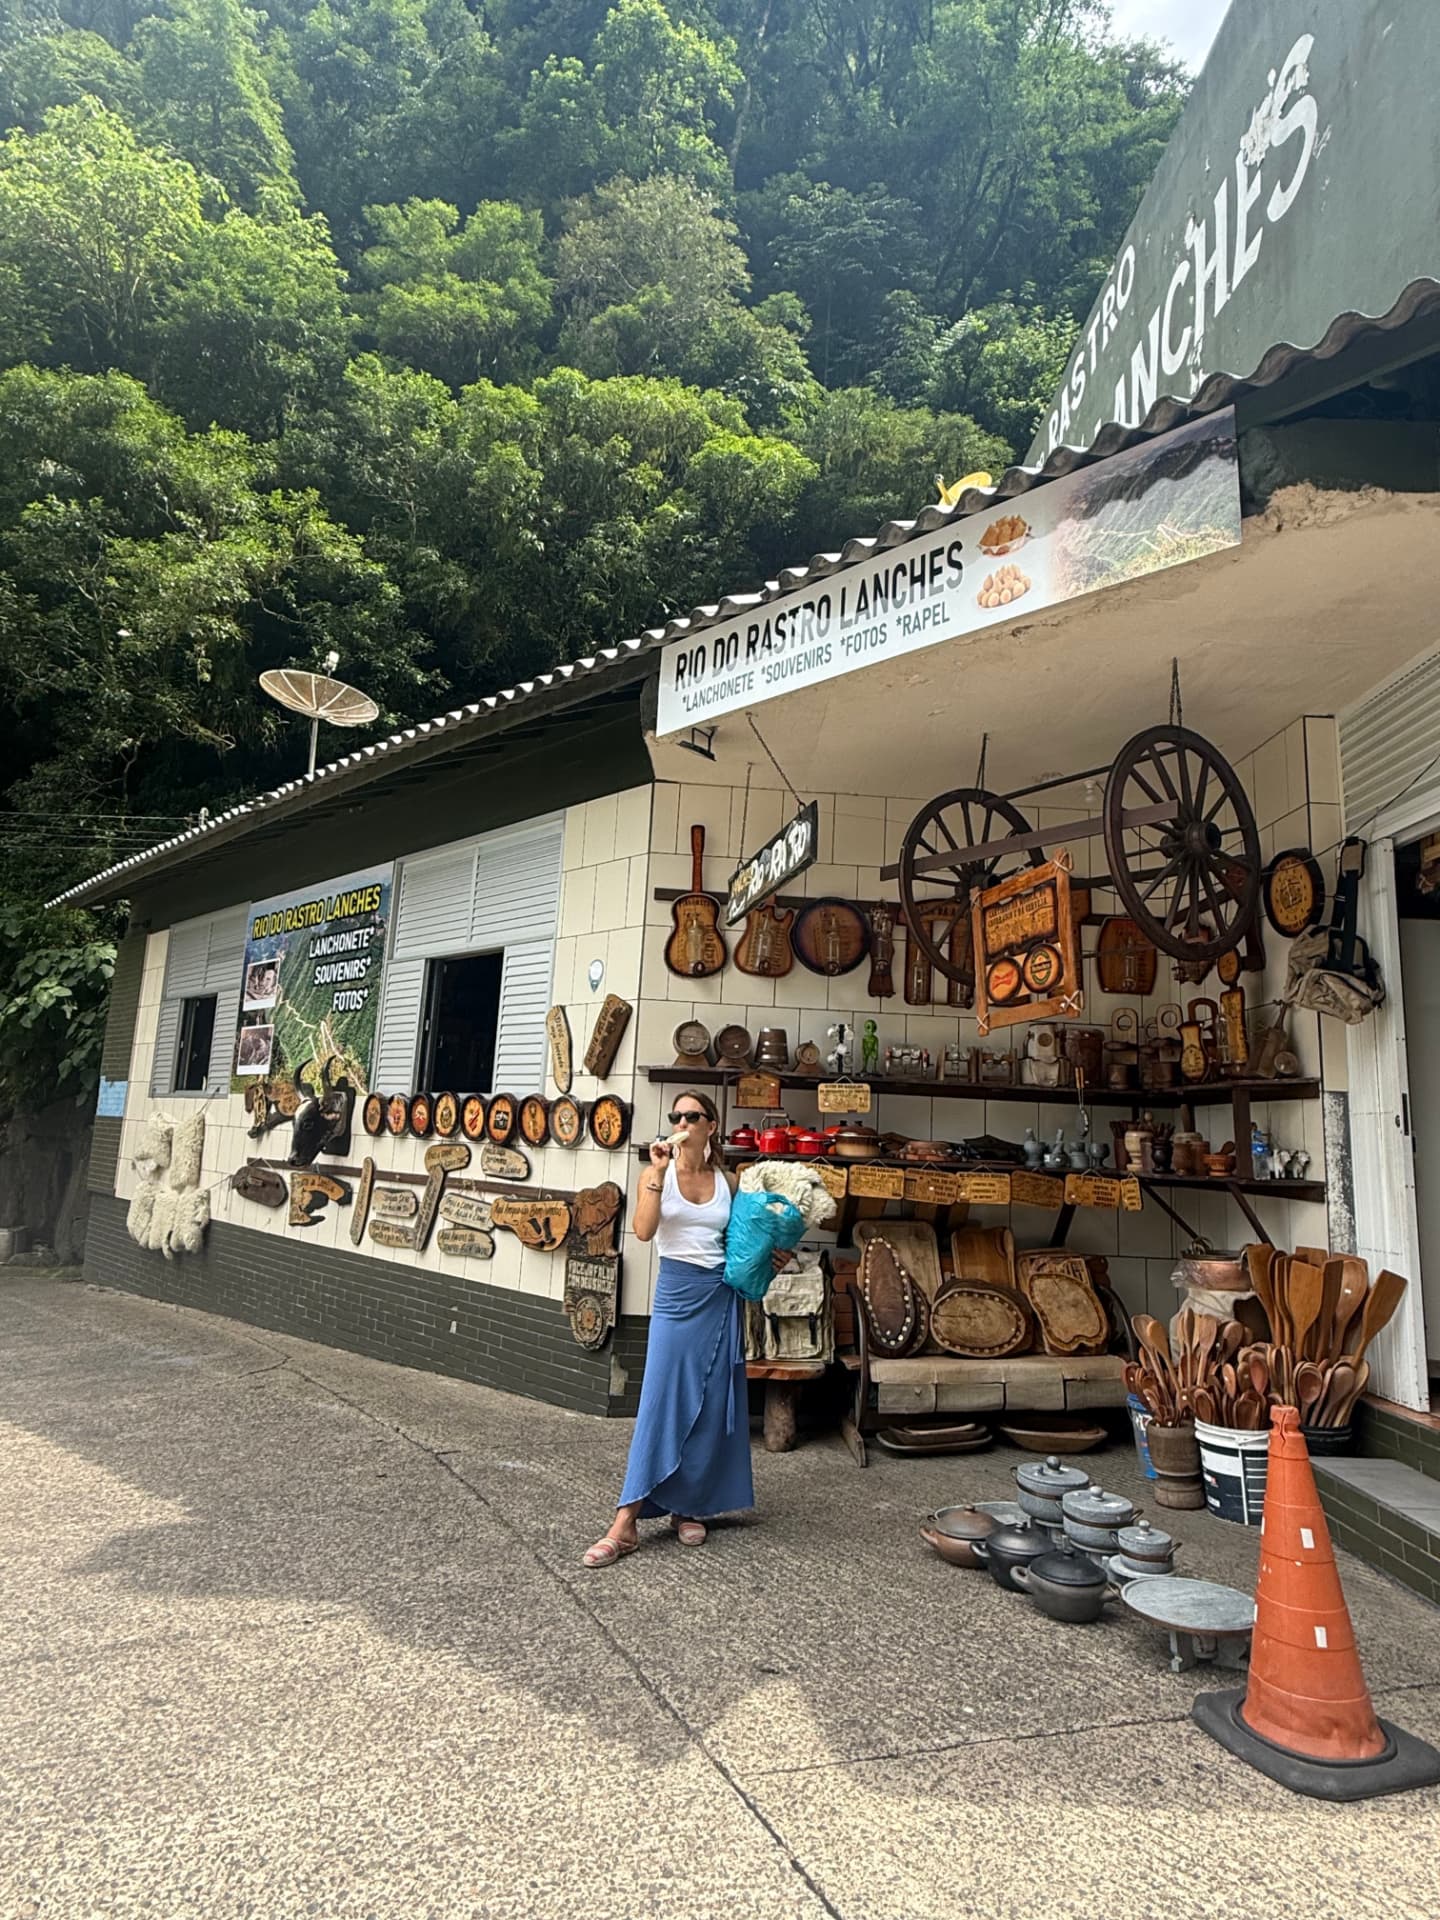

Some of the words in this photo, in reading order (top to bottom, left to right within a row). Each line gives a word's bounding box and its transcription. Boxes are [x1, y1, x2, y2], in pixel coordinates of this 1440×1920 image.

[1094, 33, 1319, 437] ANCHES
[675, 644, 707, 692] RIO
[712, 631, 739, 678] DO
[745, 593, 832, 666] RASTRO
[839, 540, 964, 631] LANCHES
[253, 916, 269, 940] RIO
[270, 911, 285, 934] DO
[284, 899, 325, 932] RASTRO
[326, 885, 382, 921] LANCHES
